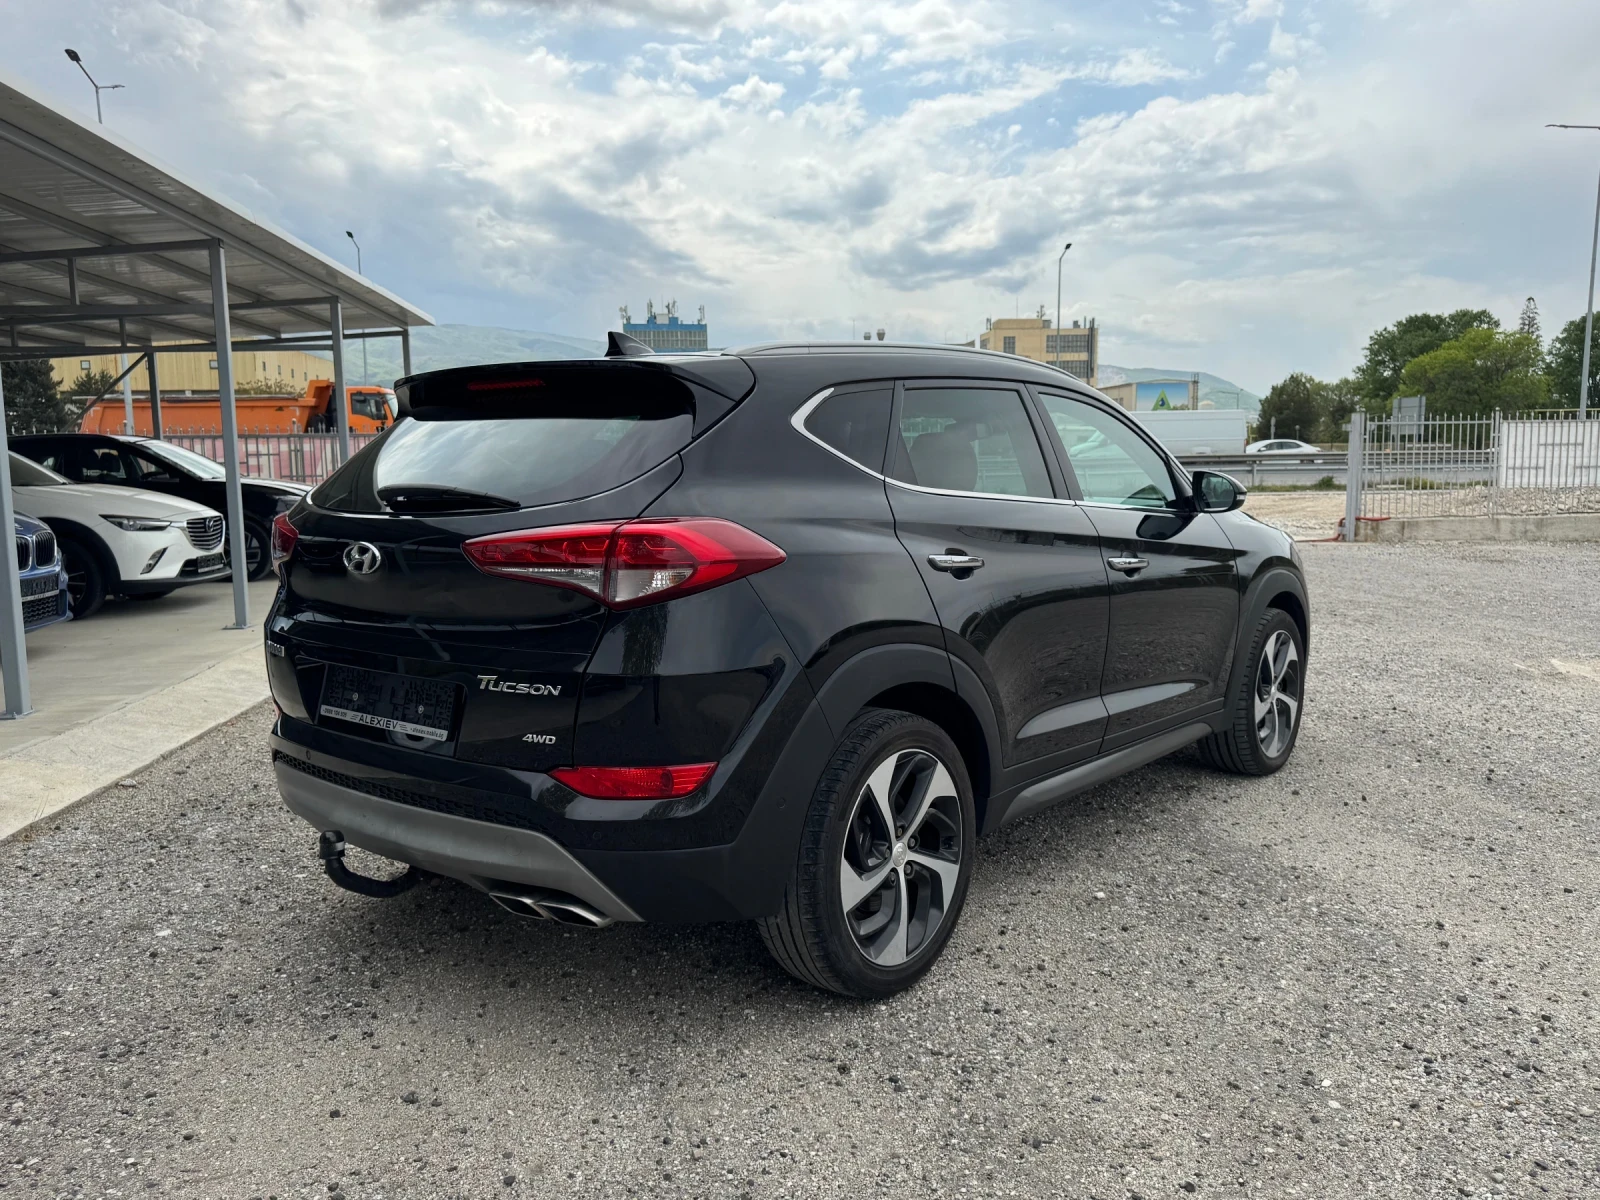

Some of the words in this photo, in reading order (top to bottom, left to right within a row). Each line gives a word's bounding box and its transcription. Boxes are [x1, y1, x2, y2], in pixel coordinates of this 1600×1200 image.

[477, 674, 562, 696] TUCSON
[359, 714, 399, 730] ALEXIEV
[522, 733, 557, 745] 4WD
